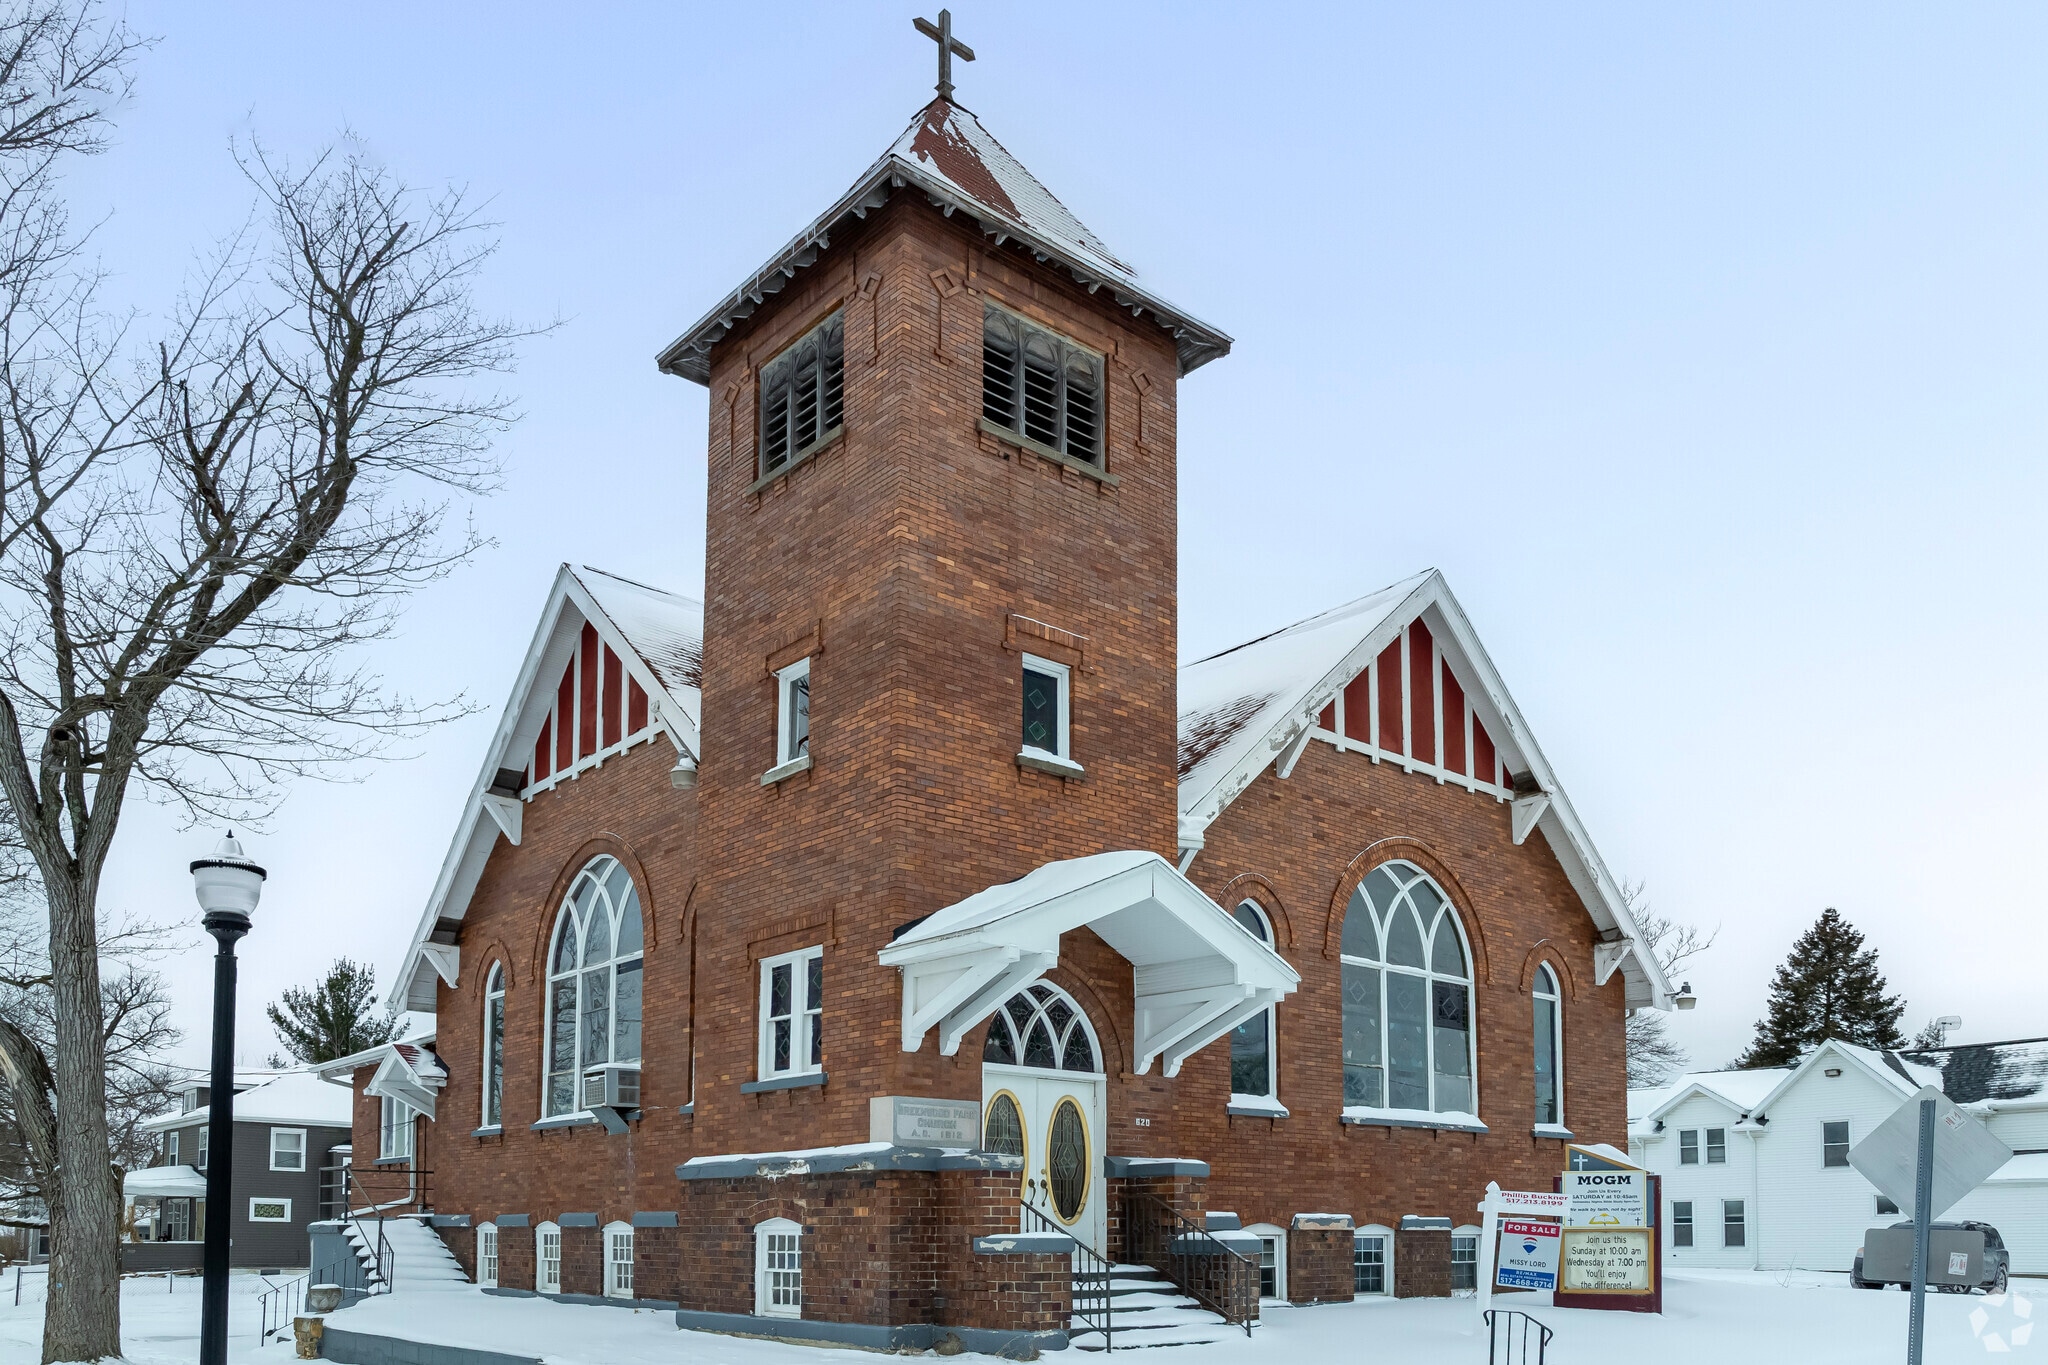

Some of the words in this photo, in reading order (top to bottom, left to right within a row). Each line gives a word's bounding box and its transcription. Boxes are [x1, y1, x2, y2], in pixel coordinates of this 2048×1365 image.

[1578, 1176, 1631, 1185] MOGM
[1572, 1247, 1596, 1256] Sunday
[1610, 1247, 1628, 1255] 10:00
[1567, 1258, 1604, 1268] Wednesday
[1618, 1258, 1633, 1266] 7:00
[1586, 1269, 1605, 1278] You'll
[1608, 1270, 1626, 1279] enjoy
[1500, 1277, 1552, 1288] 517-668-6714
[1595, 1281, 1631, 1289] difference!
